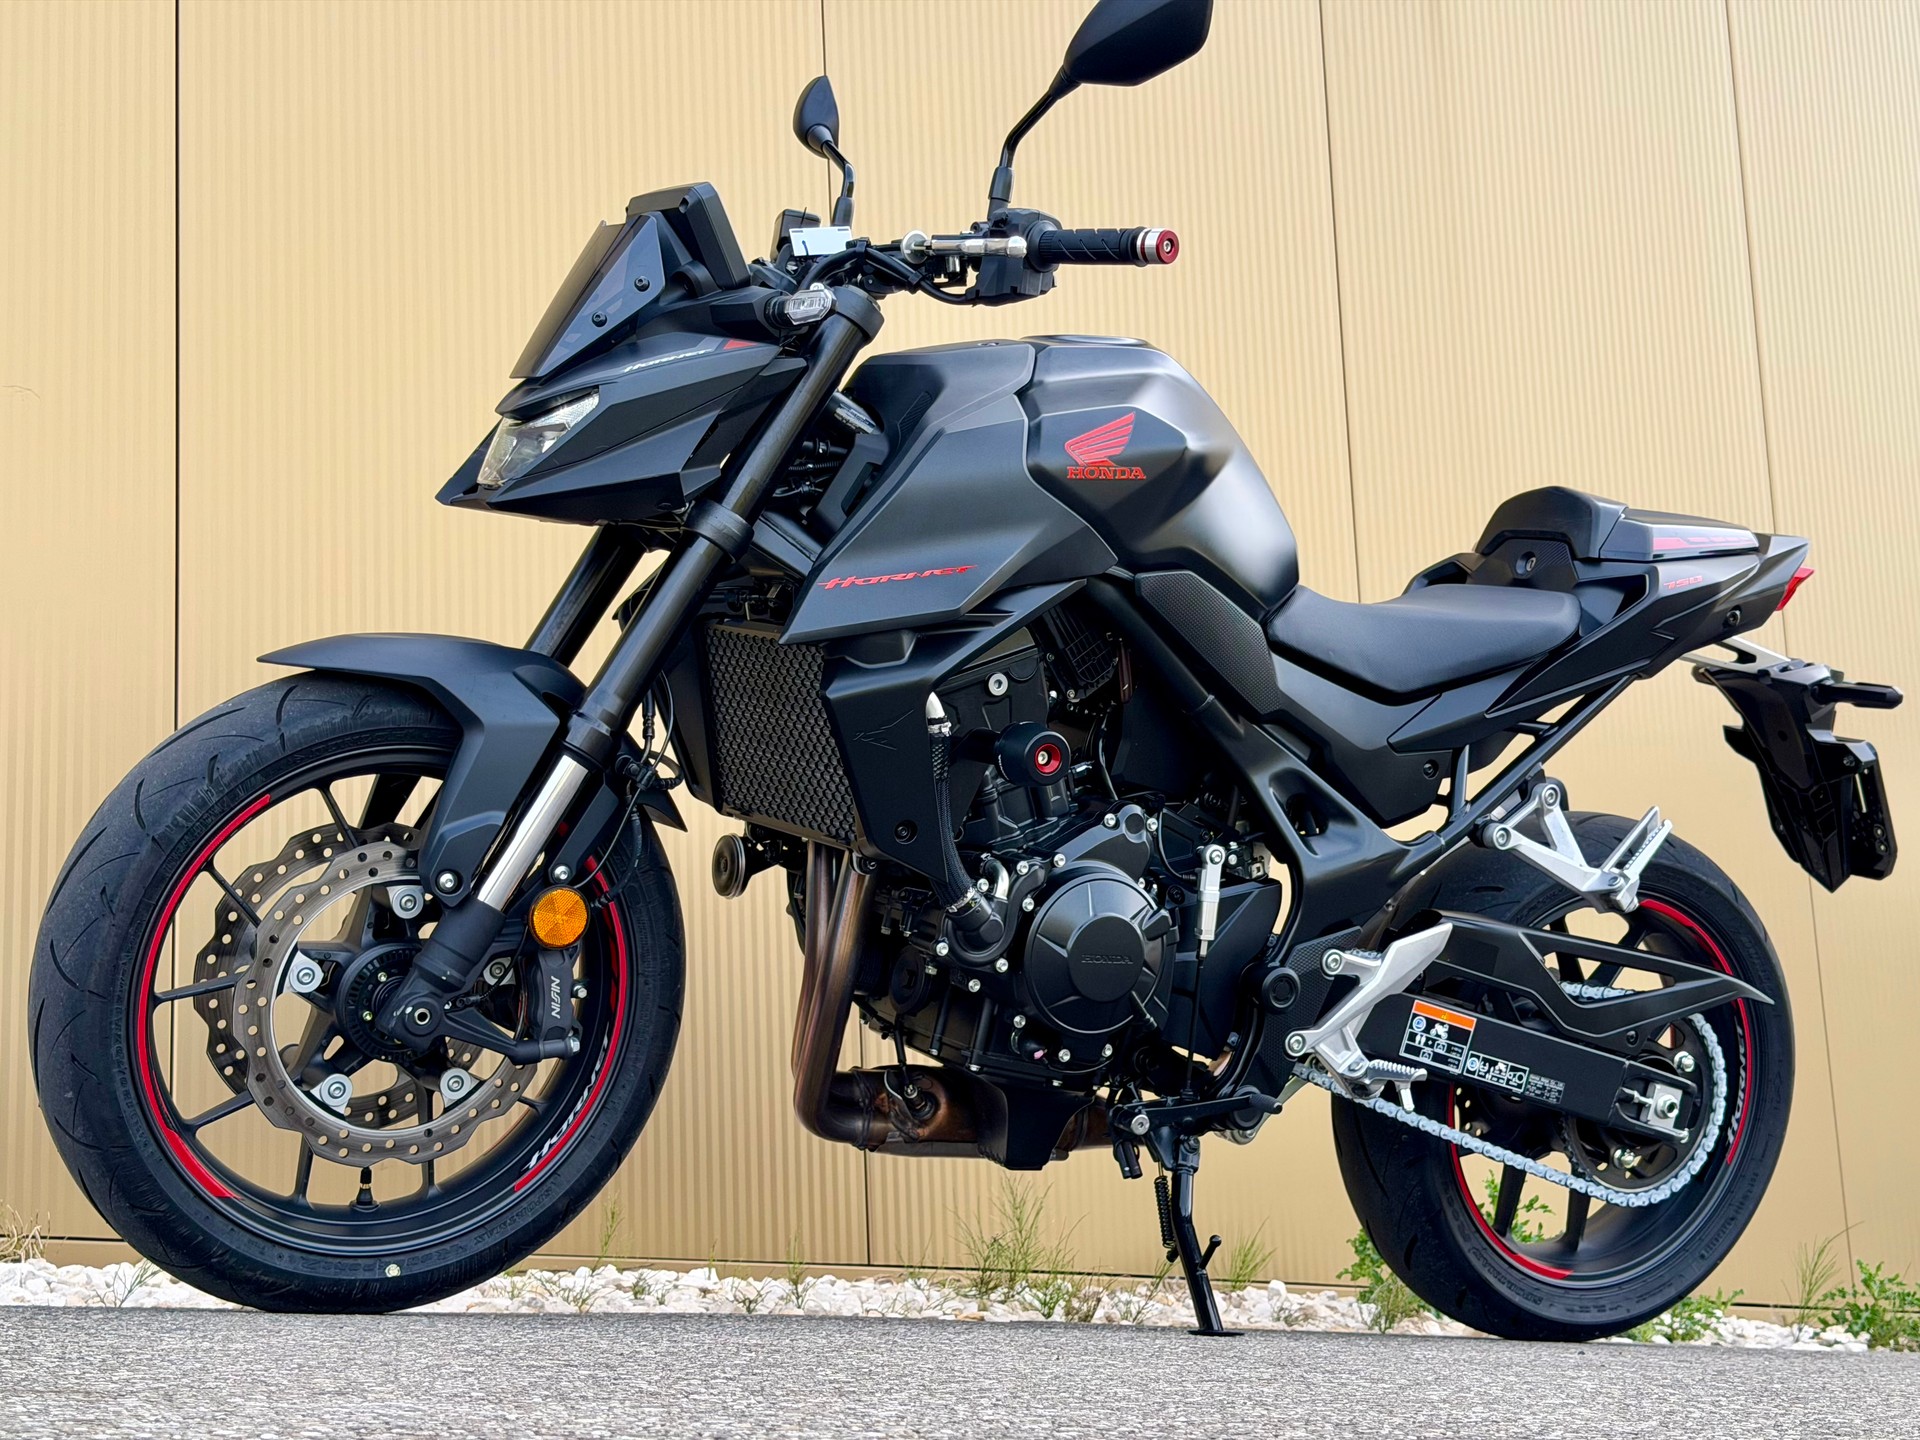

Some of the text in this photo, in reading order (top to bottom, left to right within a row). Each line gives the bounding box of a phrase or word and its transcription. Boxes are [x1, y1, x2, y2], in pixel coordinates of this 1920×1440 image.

[1066, 466, 1146, 480] HONDA
[816, 564, 978, 590] HORNET
[1663, 575, 1703, 590] 750
